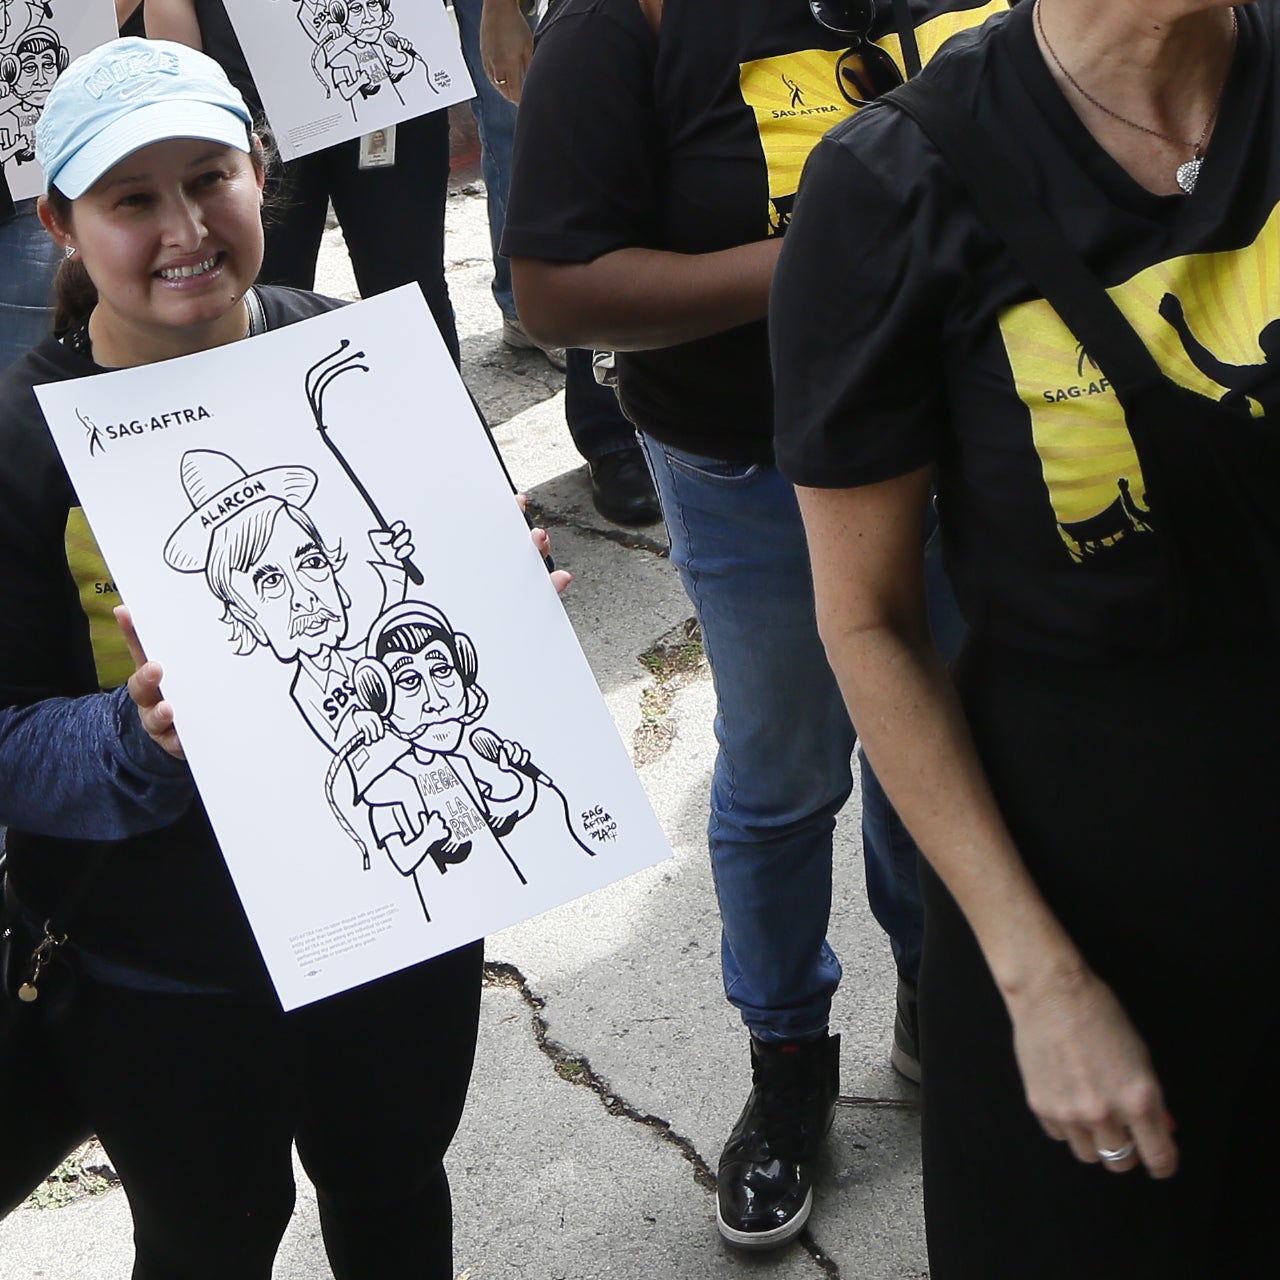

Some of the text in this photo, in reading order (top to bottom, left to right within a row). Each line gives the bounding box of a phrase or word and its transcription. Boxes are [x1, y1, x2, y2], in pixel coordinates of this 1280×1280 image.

[84, 51, 179, 100] NIKE
[1043, 379, 1114, 404] SAG·AF
[105, 404, 211, 441] SAG·AFTRA
[199, 479, 268, 529] ALARCÓN
[418, 766, 460, 797] MEGA
[445, 796, 468, 817] LA
[582, 805, 604, 821] SAG
[449, 808, 486, 841] RAZA
